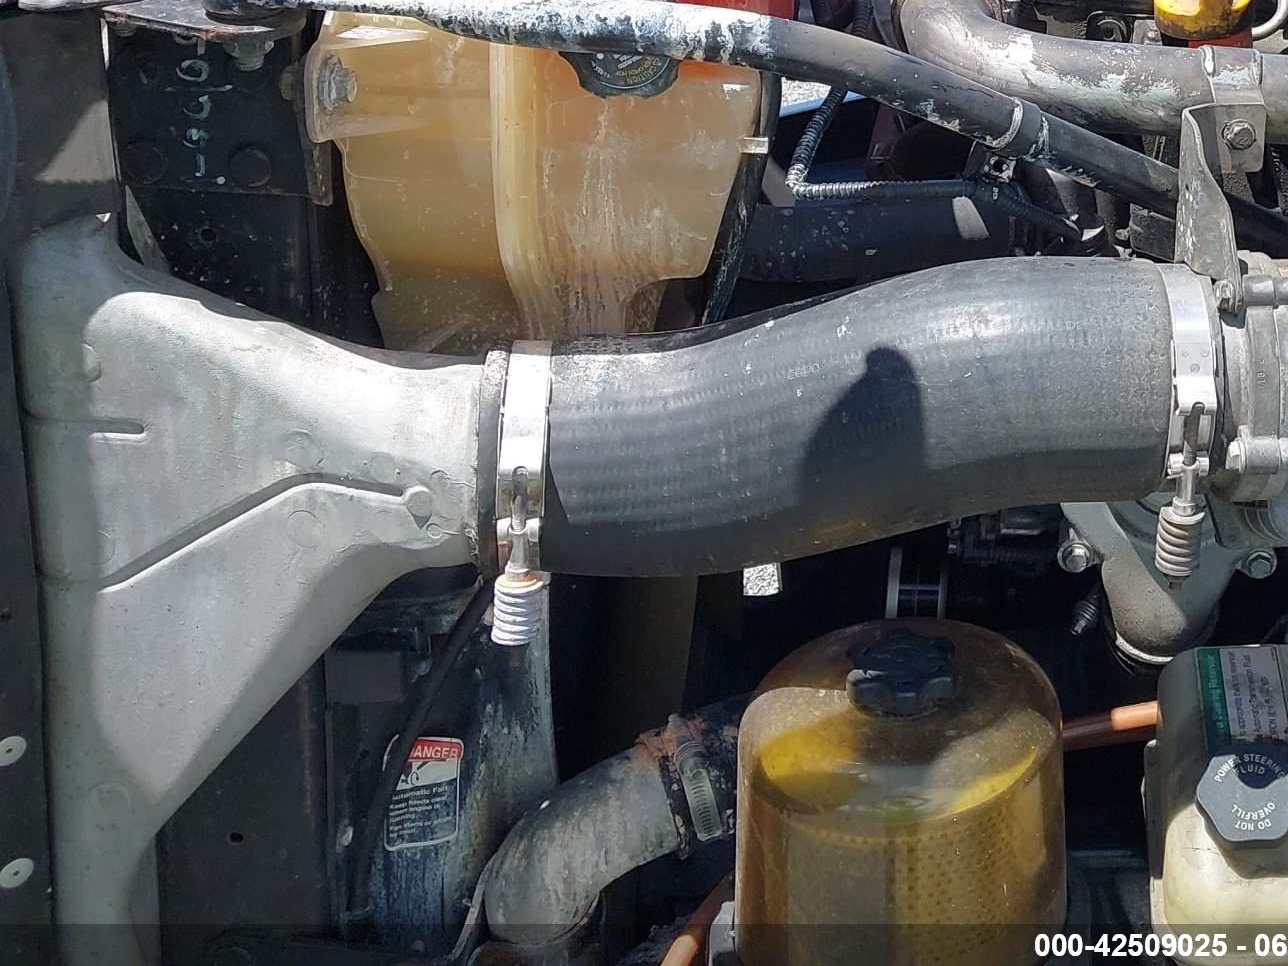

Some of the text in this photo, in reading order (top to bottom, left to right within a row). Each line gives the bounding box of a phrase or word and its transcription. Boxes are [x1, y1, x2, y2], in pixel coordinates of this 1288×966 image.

[409, 745, 459, 759] ANGER
[1214, 753, 1286, 783] POWER STEERING
[1231, 801, 1276, 821] OVERFILL
[1234, 818, 1272, 831] DO NOT
